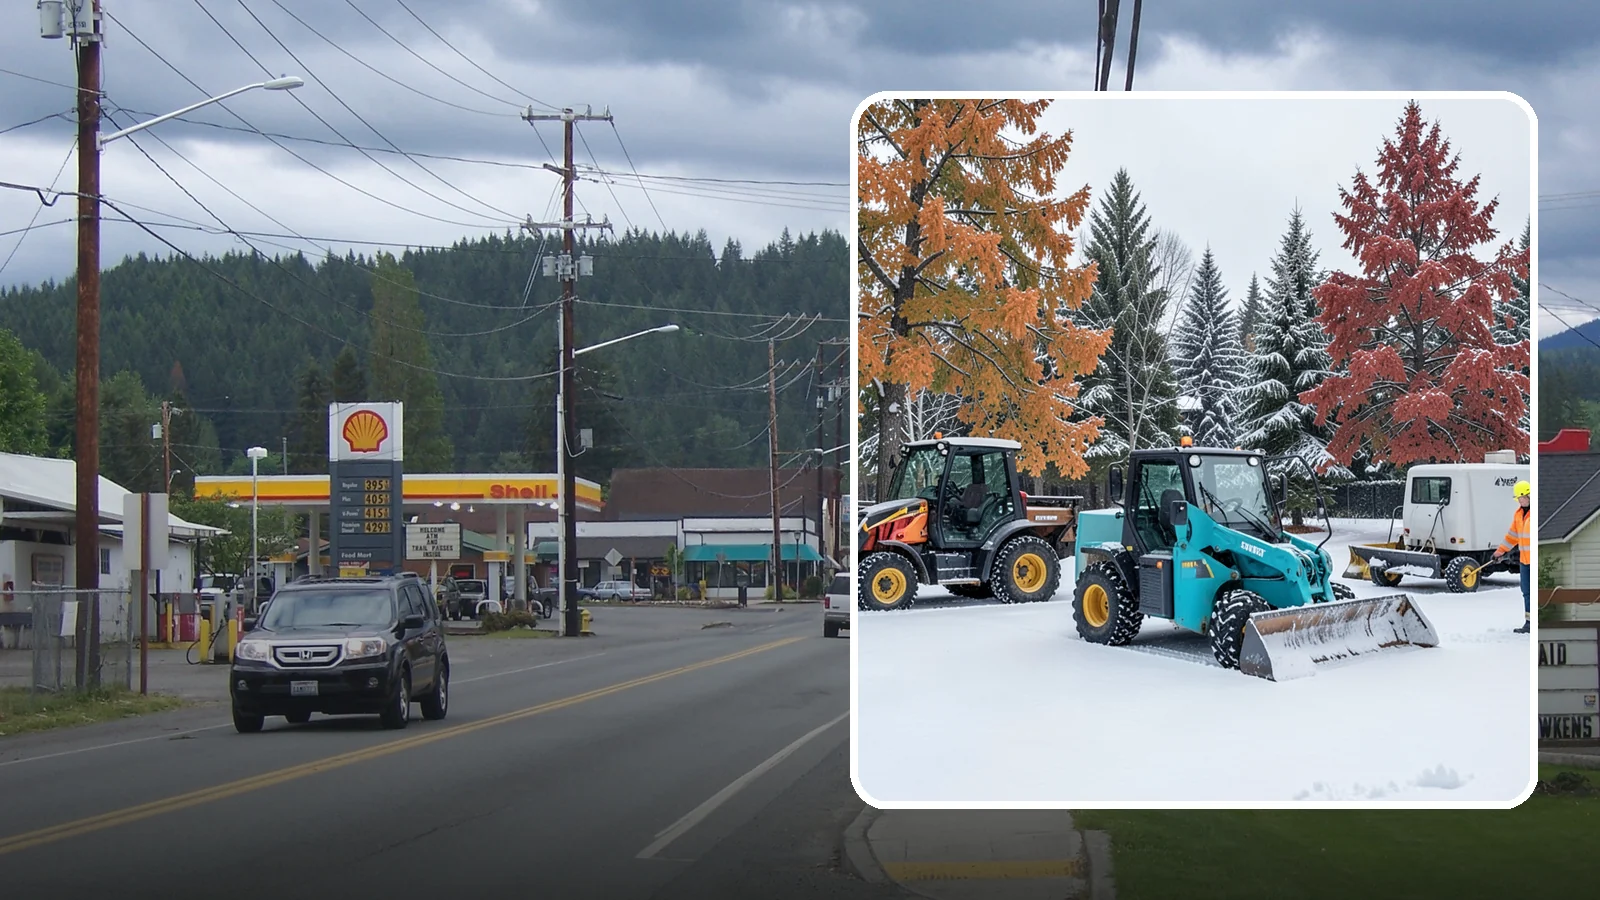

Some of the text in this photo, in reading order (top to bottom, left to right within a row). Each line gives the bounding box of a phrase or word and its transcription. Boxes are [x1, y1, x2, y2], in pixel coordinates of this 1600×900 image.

[366, 480, 384, 490] 395
[490, 484, 547, 499] Shell
[366, 494, 384, 504] 405
[366, 508, 384, 518] 415
[366, 522, 384, 531] 429
[1538, 643, 1567, 665] AID
